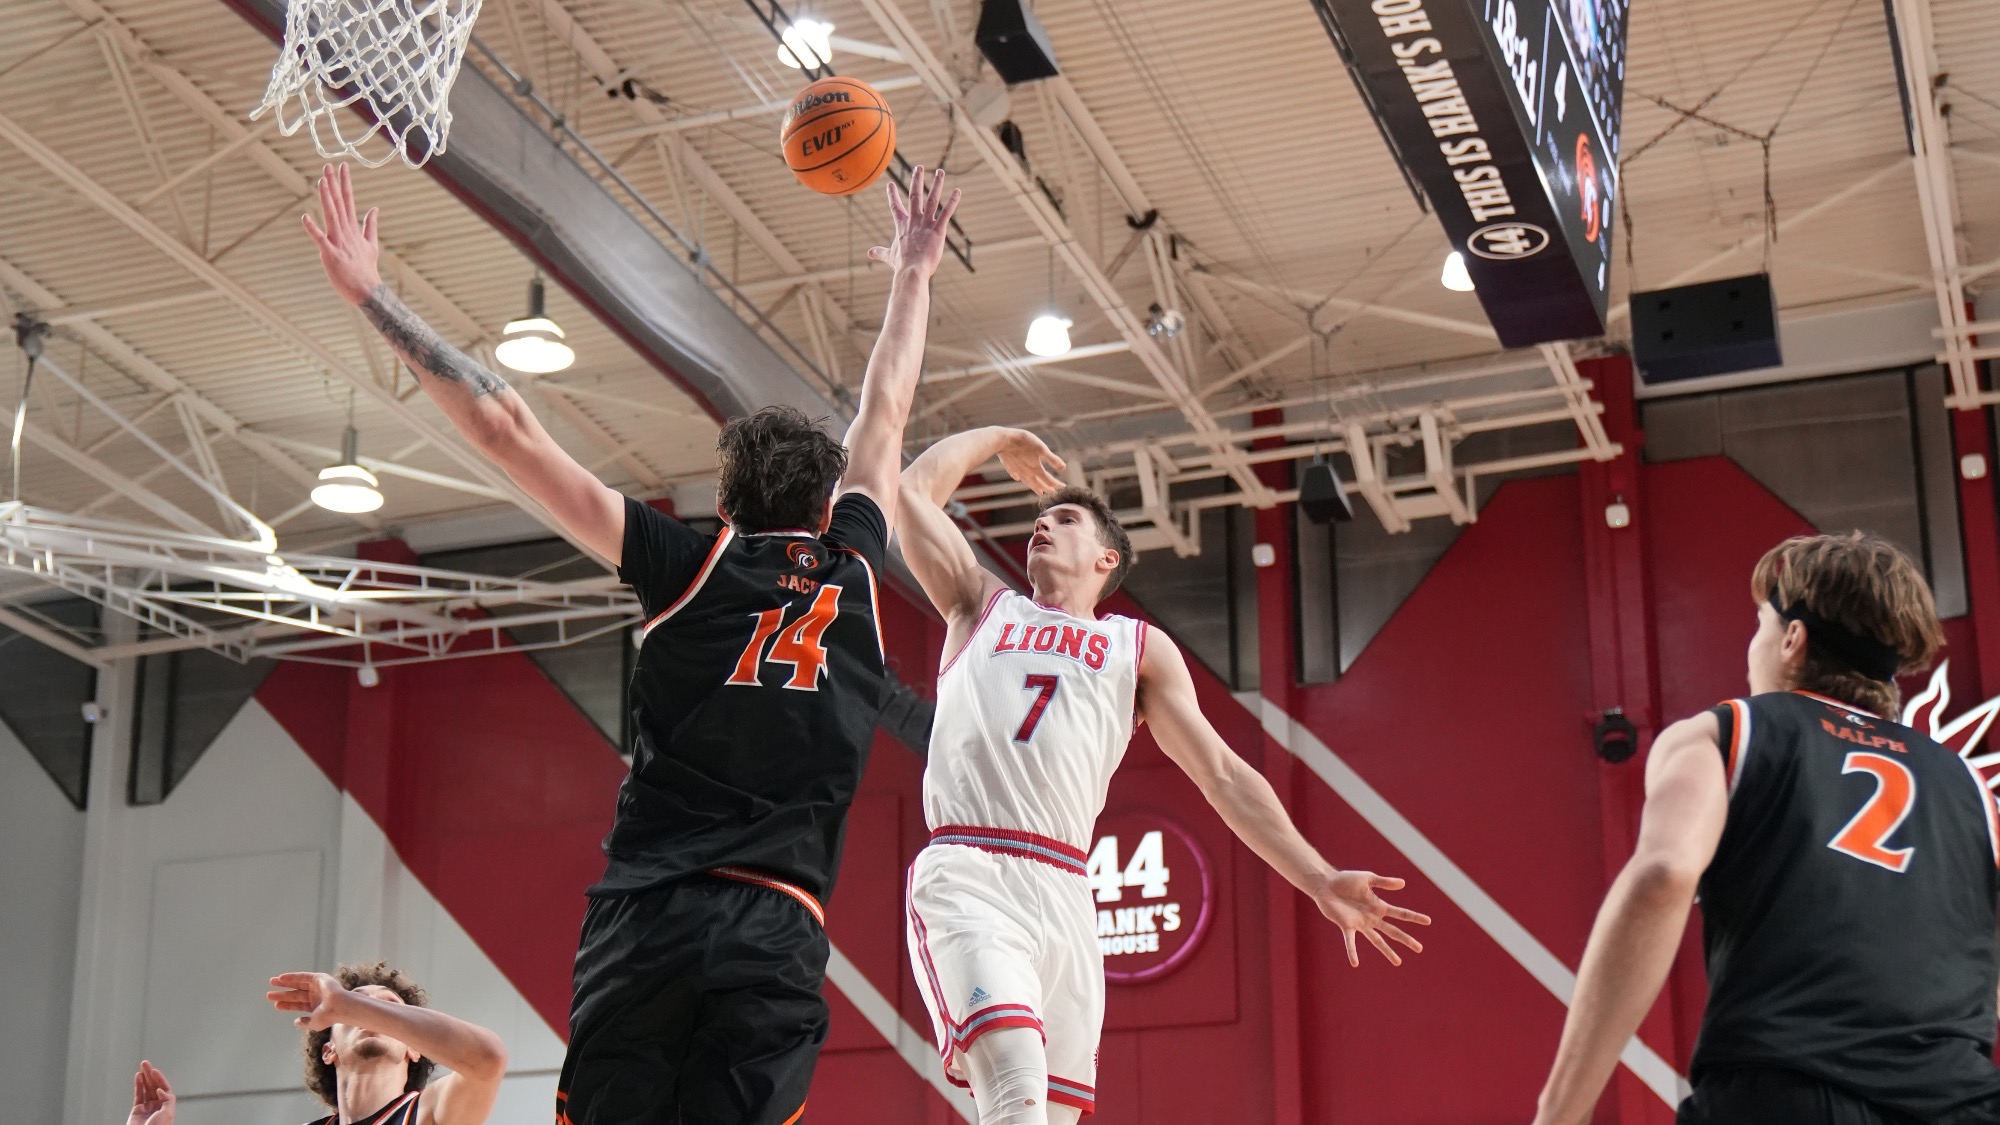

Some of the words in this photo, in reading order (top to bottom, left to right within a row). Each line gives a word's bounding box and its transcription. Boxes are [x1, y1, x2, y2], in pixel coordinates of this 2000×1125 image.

[1391, 37, 1480, 138] HANK'S
[1440, 138, 1492, 166] IS
[1453, 165, 1516, 222] THIS
[1483, 228, 1531, 254] 44
[724, 584, 843, 691] 14
[991, 623, 1112, 675] LIONS
[1012, 673, 1060, 744] 7
[1820, 719, 1909, 753] RALPH
[1827, 752, 1917, 873] 2
[1087, 831, 1170, 903] 44
[969, 994, 991, 1007] adidas
